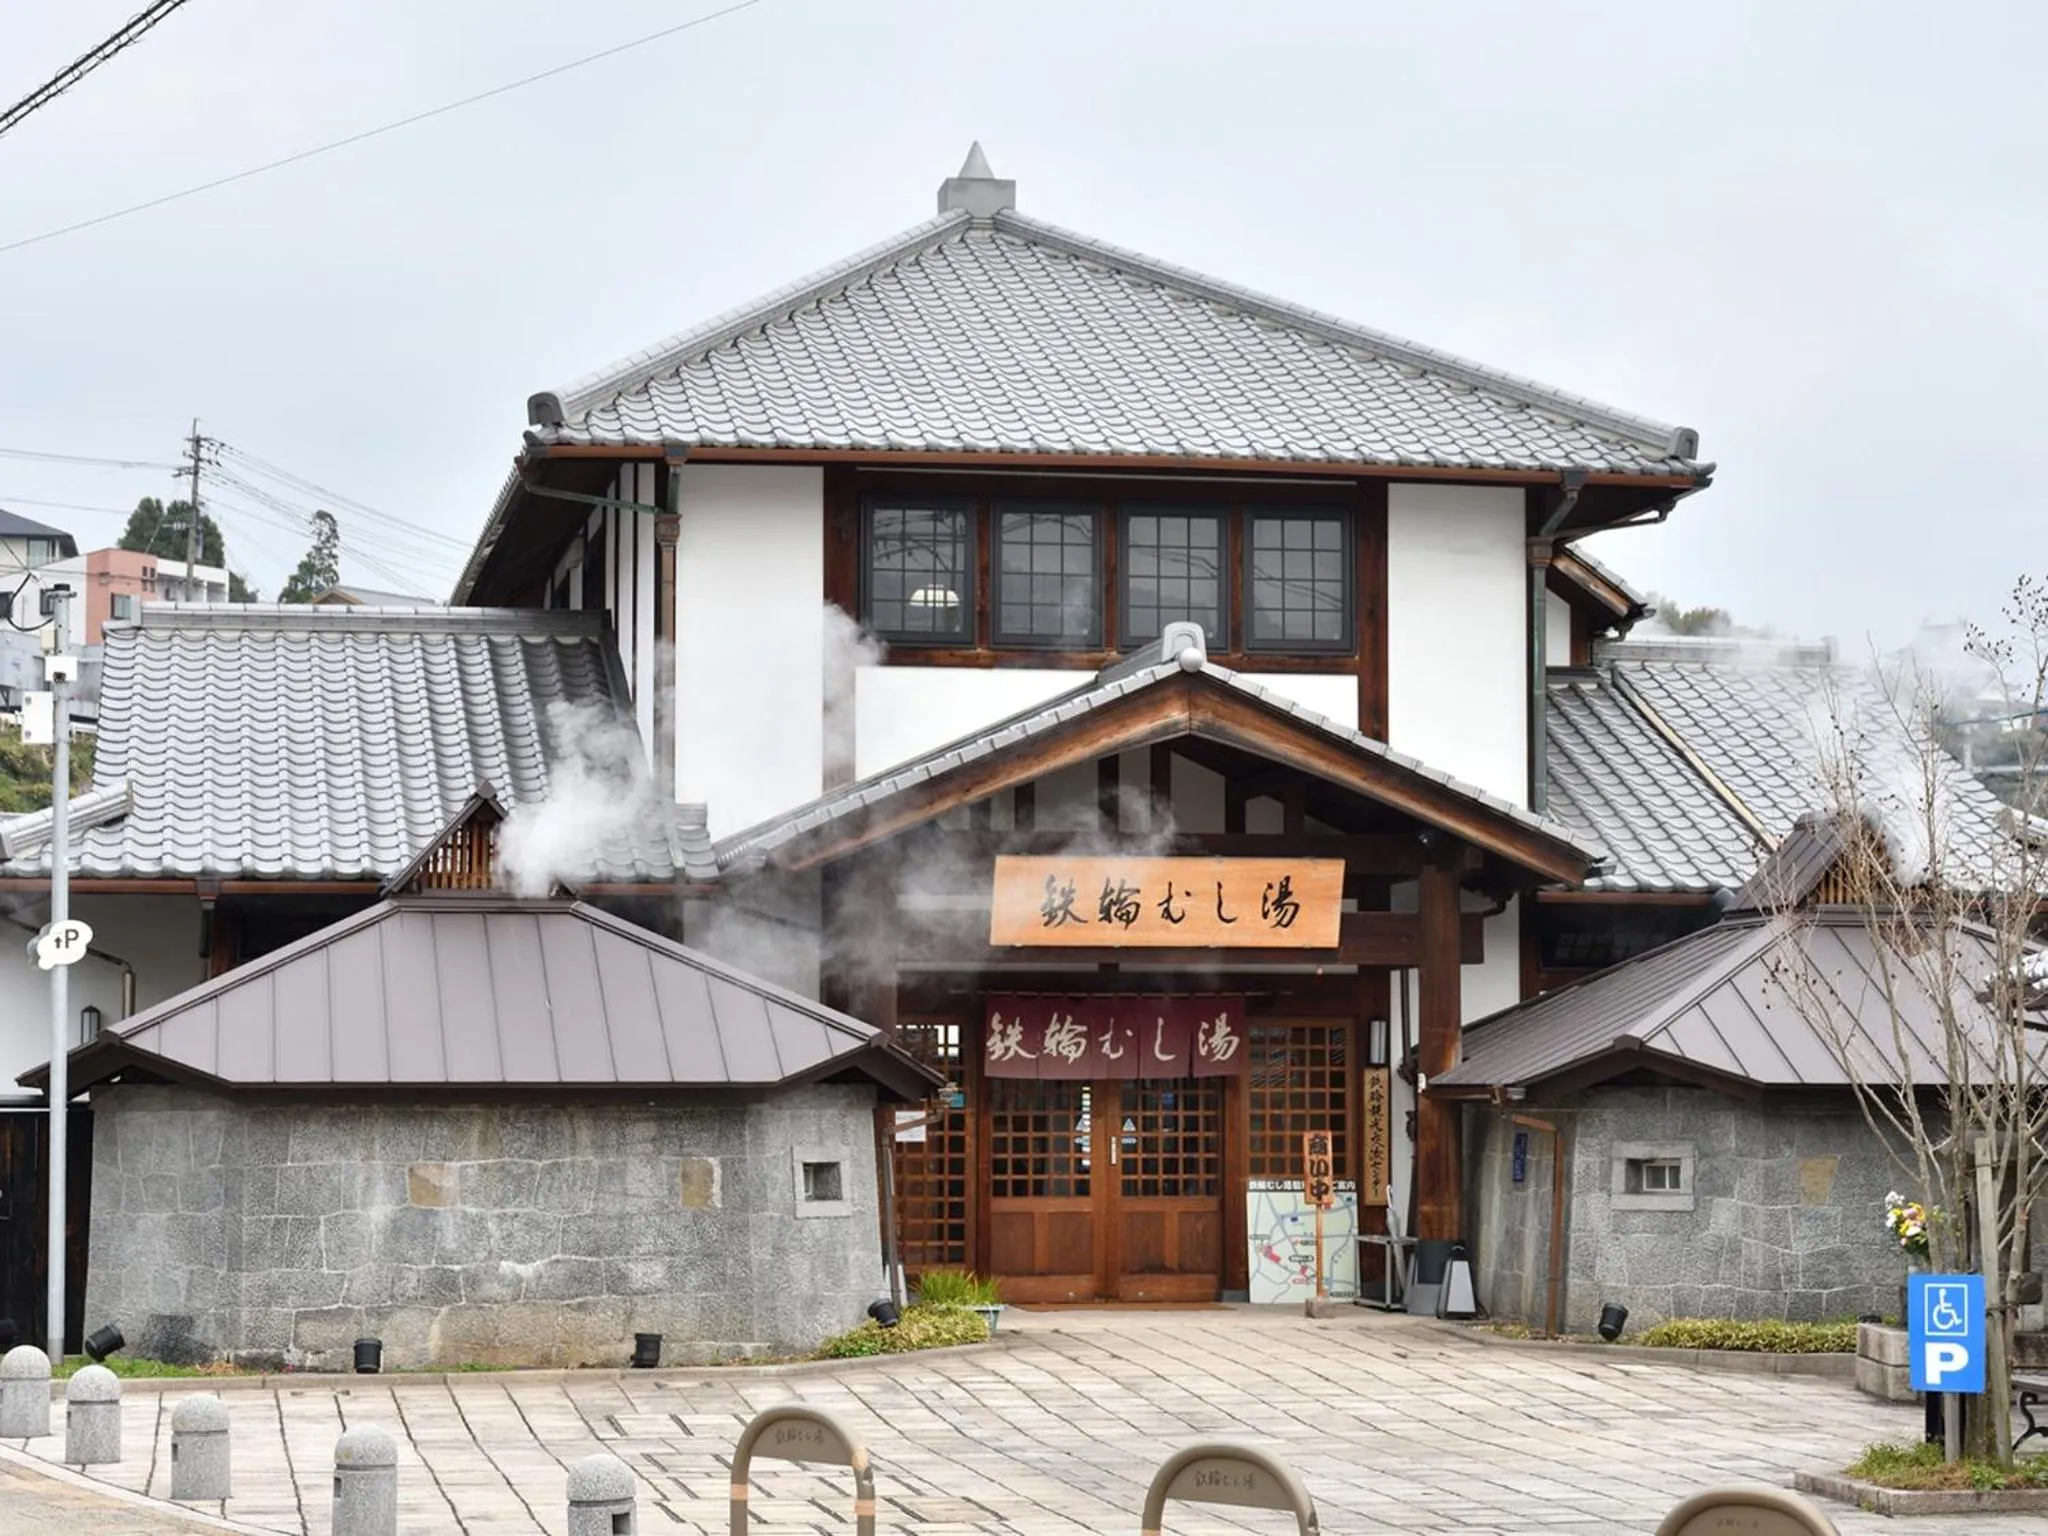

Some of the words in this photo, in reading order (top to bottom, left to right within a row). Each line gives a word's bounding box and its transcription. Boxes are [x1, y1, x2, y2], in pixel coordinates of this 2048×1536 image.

[1040, 873, 1301, 930] 鉄輪むし湯
[65, 928, 80, 949] P
[985, 1011, 1241, 1064] 鉄輪むし湯
[1308, 1133, 1330, 1202] 商い中
[1924, 1341, 1969, 1385] P
